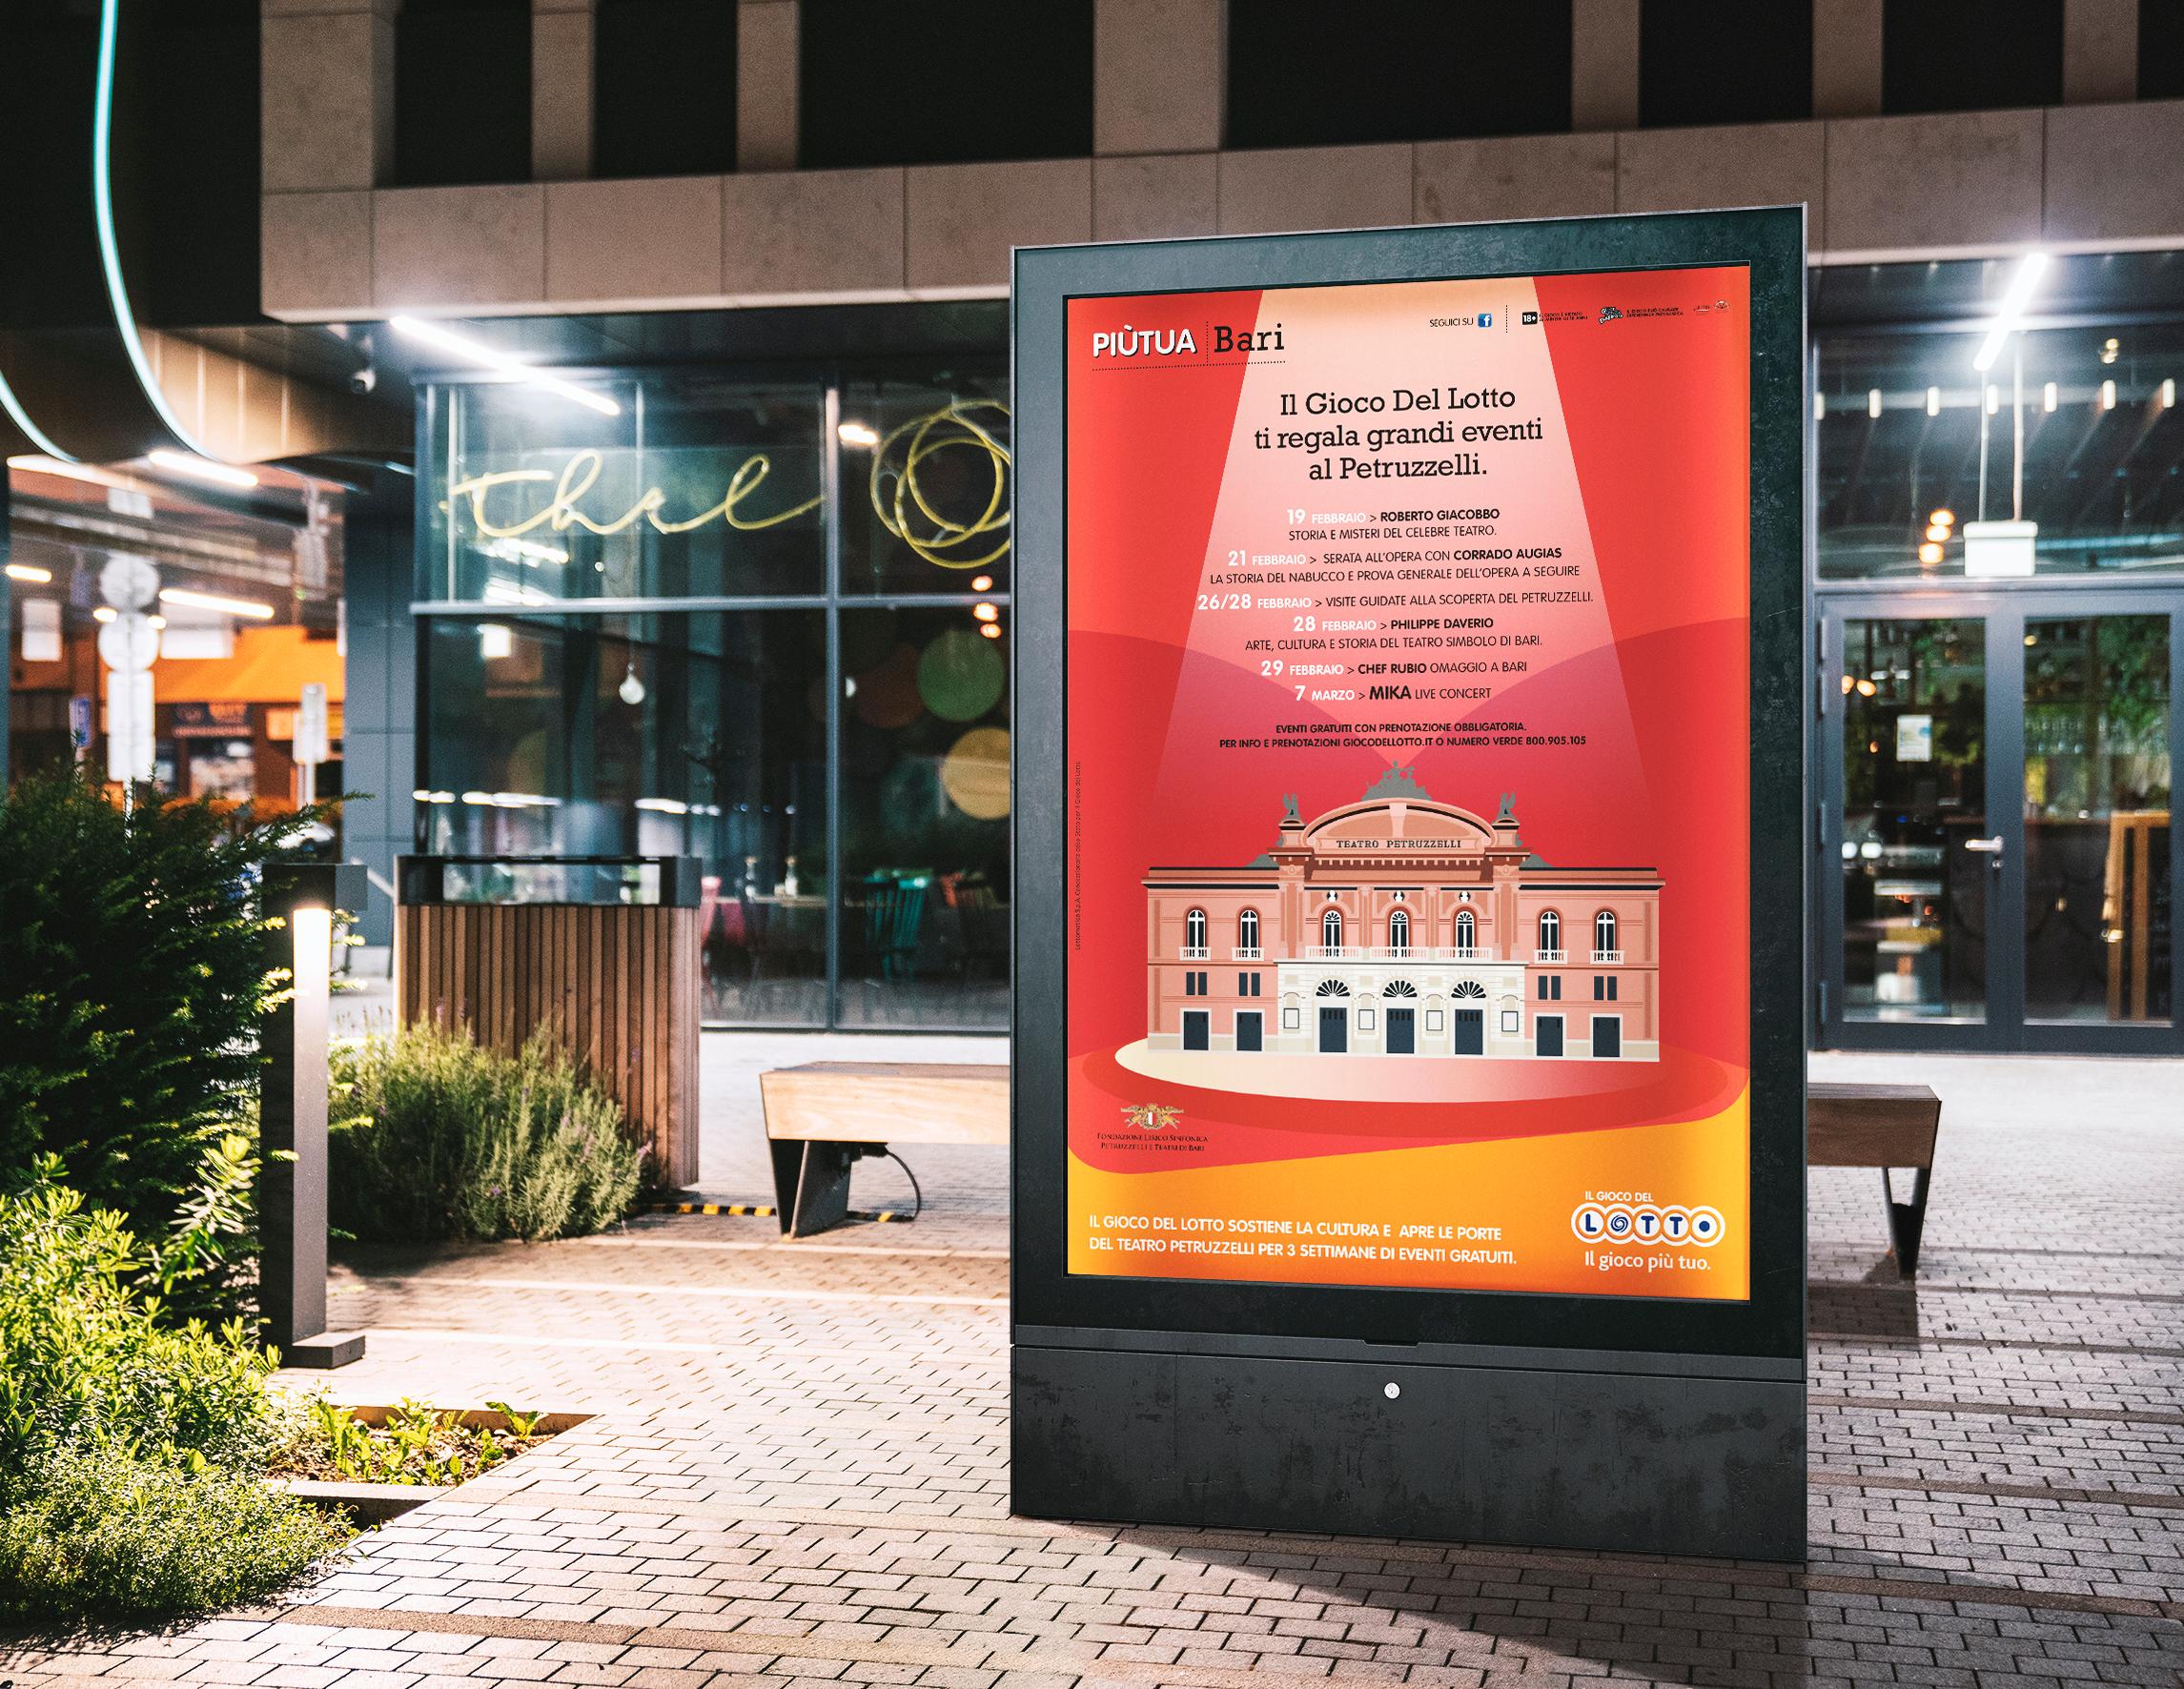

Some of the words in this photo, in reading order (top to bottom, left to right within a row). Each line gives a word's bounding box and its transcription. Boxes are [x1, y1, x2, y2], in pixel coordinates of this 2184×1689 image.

[1429, 317, 1460, 328] SEGUICI
[1462, 316, 1474, 326] SU
[1092, 324, 1196, 358] PIÙTUA
[1214, 323, 1285, 354] Bari
[1280, 394, 1297, 416] Il
[1305, 392, 1385, 415] Gioco
[1393, 388, 1440, 411] Del
[1447, 387, 1516, 410] Lotto
[1255, 427, 1271, 449] ti
[1277, 425, 1359, 454] regala
[1367, 421, 1455, 452] grandi
[1461, 417, 1543, 441] eventi
[1309, 458, 1332, 480] al
[1339, 453, 1487, 479] Petruzzelli.
[1287, 508, 1306, 525] 19
[1312, 512, 1366, 524] FEBBRAIO
[1380, 510, 1434, 522] ROBERTO
[1437, 508, 1500, 520] GIACOBBO
[1289, 530, 1327, 540] STORIA
[1330, 529, 1337, 539] E
[1339, 528, 1379, 539] MISTERI
[1383, 527, 1402, 539] DEL
[1405, 526, 1450, 538] CELEBRE
[1454, 525, 1497, 537] TEATRO.
[1228, 550, 1246, 566] 21
[1252, 554, 1306, 565] FEBBRAIO
[1323, 552, 1361, 563] SERATA
[1424, 550, 1450, 561] CON
[1453, 548, 1513, 560] CORRADO
[1516, 547, 1562, 560] AUGIAS
[1211, 574, 1223, 584] LA
[1226, 573, 1264, 584] STORIA
[1267, 573, 1286, 583] DEL
[1289, 571, 1345, 582] NABUCCO
[1348, 571, 1354, 580] E
[1357, 570, 1394, 581] PROVA
[1398, 568, 1452, 580] GENERALE
[1521, 566, 1531, 578] A
[1534, 565, 1580, 577] SEGUIRE
[1197, 593, 1252, 610] 26/28
[1257, 597, 1312, 609] FEBBRAIO
[1325, 596, 1356, 607] VISITE
[1359, 595, 1406, 607] GUIDATE
[1409, 594, 1437, 605] ALLA
[1439, 593, 1495, 605] SCOPERTA
[1499, 592, 1518, 603] DEL
[1521, 591, 1594, 603] PETRUZZELLI.
[1293, 616, 1316, 632] 28
[1322, 620, 1377, 631] FEBBRAIO
[1391, 619, 1440, 630] PHILIPPE
[1443, 618, 1494, 629] DAVERIO
[1245, 640, 1274, 652] ARTE,
[1277, 639, 1326, 650] CULTURA
[1330, 639, 1336, 649] E
[1338, 638, 1378, 649] STORIA
[1380, 637, 1399, 648] DEL
[1402, 637, 1443, 648] TEATRO
[1446, 636, 1497, 647] SIMBOLO
[1500, 635, 1510, 646] DI
[1515, 635, 1542, 646] BARI.
[1261, 660, 1284, 676] 29
[1290, 664, 1344, 676] FEBBRAIO
[1357, 663, 1387, 675] CHEF
[1391, 663, 1427, 674] RUBIO
[1430, 661, 1487, 673] OMAGGIO
[1490, 661, 1499, 672] A
[1502, 661, 1527, 672] BARI
[1295, 684, 1306, 702] 7
[1312, 690, 1356, 701] MARZO
[1369, 685, 1412, 701] MIKA
[1415, 688, 1436, 700] LIVE
[1439, 687, 1492, 699] CONCERT
[1276, 724, 1307, 734] EVENTI
[1310, 723, 1352, 733] GRATUITI
[1355, 723, 1377, 733] CON
[1378, 722, 1451, 733] PRENOTAZIONE
[1454, 722, 1527, 732] OBBLIGATORIA.
[1219, 739, 1236, 748] PER
[1239, 739, 1261, 748] INFO
[1264, 739, 1269, 748] E
[1272, 738, 1341, 747] PRENOTAZIONI
[1342, 737, 1433, 747] GIOCODELLOTTO.IT
[1436, 737, 1444, 746] O
[1446, 736, 1490, 746] NUMERO
[1492, 736, 1523, 746] VERDE
[1525, 735, 1586, 745] 800.905.105
[1336, 840, 1379, 848] TEATRO
[1386, 840, 1461, 848] PETRUZZELLI
[1585, 1190, 1594, 1200] IL
[1597, 1190, 1632, 1202] GIOCO
[1635, 1191, 1654, 1202] DEL
[1090, 1214, 1099, 1228] IL
[1103, 1215, 1150, 1230] GIOCO
[1153, 1217, 1177, 1231] DEL
[1181, 1217, 1225, 1232] LOTTO
[1228, 1219, 1293, 1234] SOSTIENE
[1296, 1221, 1313, 1235] LA
[1317, 1222, 1379, 1237] CULTURA
[1383, 1224, 1391, 1237] E
[1399, 1225, 1435, 1238] APRE
[1439, 1226, 1453, 1239] LE
[1457, 1227, 1502, 1241] PORTE
[1090, 1237, 1113, 1251] DEL
[1117, 1238, 1167, 1252] TEATRO
[1170, 1240, 1254, 1255] PETRUZZELLI
[1258, 1243, 1283, 1256] PER
[1287, 1244, 1296, 1257] 3
[1299, 1244, 1377, 1259] SETTIMANE
[1380, 1246, 1395, 1260] DI
[1398, 1248, 1446, 1262] EVENTI
[1449, 1250, 1517, 1265] GRATUITI.
[1585, 1251, 1595, 1267] Il
[1599, 1251, 1643, 1272] gioco
[1648, 1252, 1674, 1272] più
[1678, 1255, 1711, 1270] tuo.
